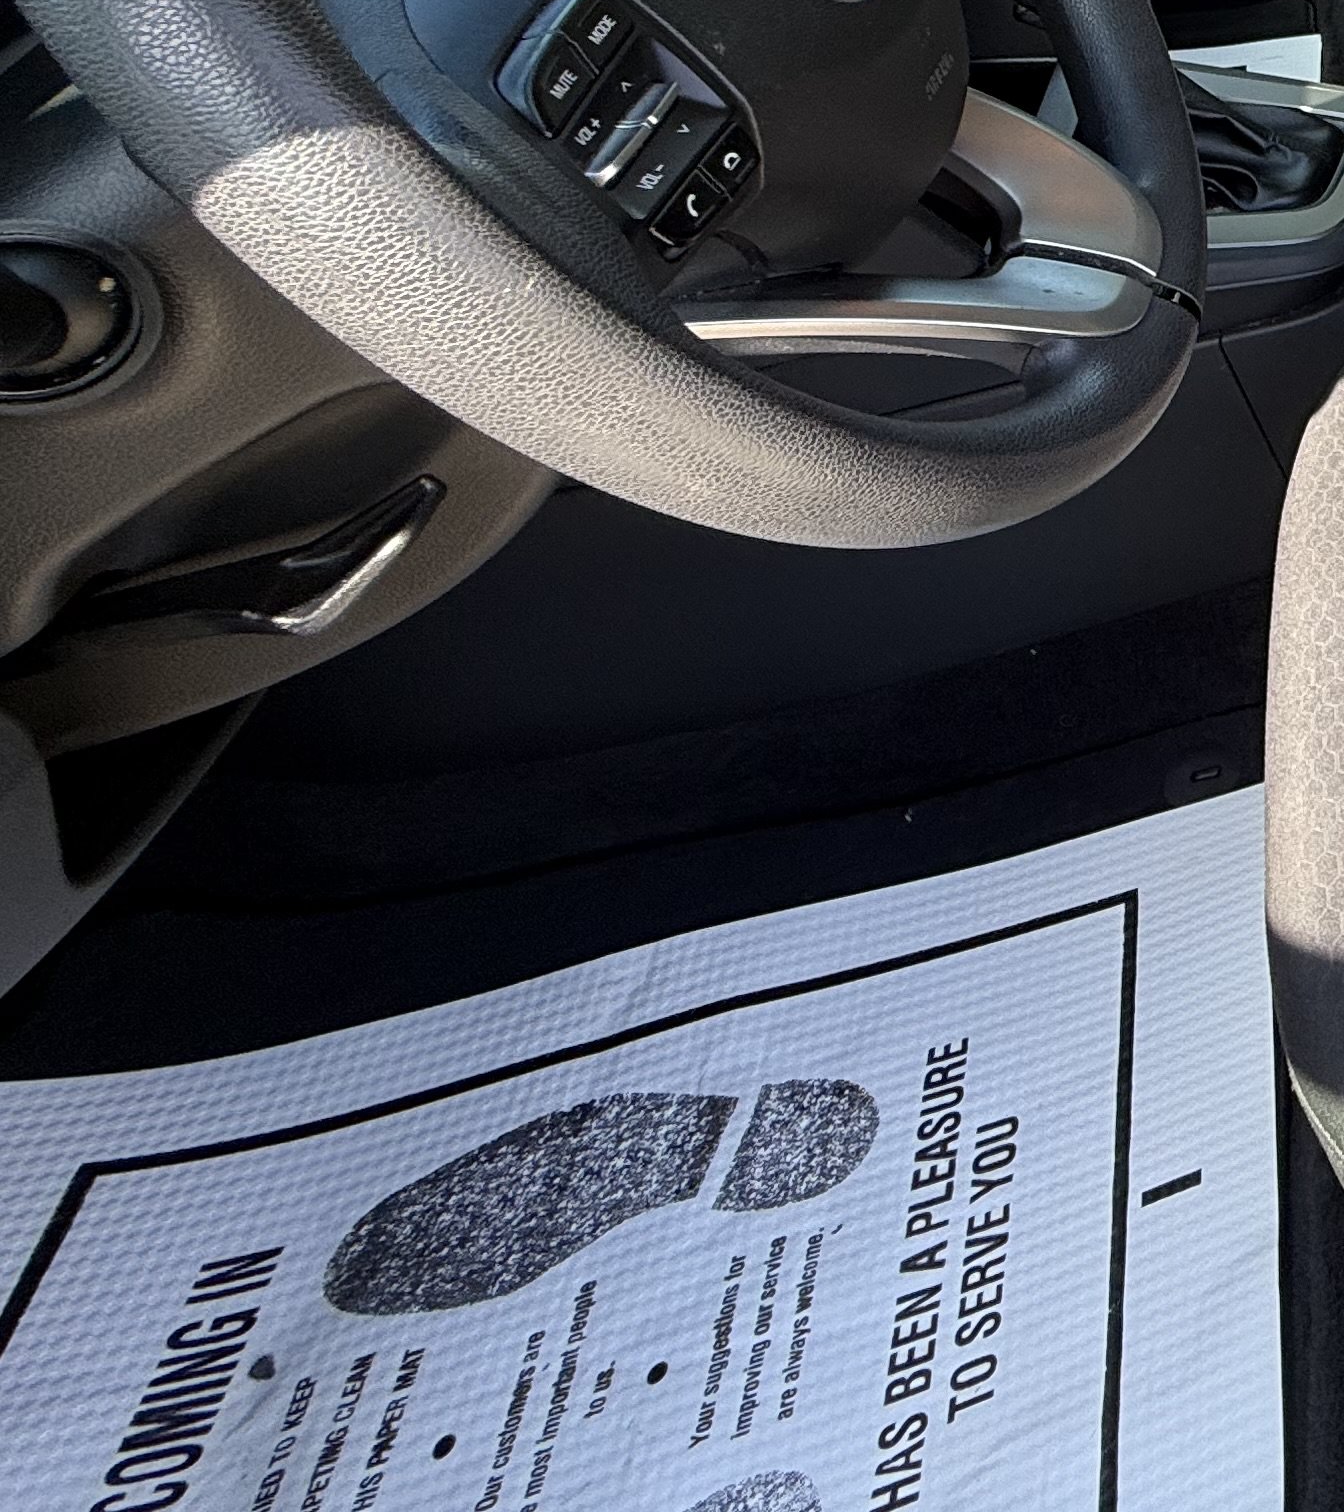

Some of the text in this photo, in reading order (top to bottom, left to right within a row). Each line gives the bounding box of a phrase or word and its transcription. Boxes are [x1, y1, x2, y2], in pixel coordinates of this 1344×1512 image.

[587, 14, 617, 46] MODE
[550, 69, 579, 100] MUTE
[761, 1235, 787, 1300] service
[868, 1037, 969, 1512] HAS BEEN A PLEASURE
[947, 1115, 1019, 1424] TO SERVE YOU
[688, 1255, 747, 1449] Your suggestions for
[754, 1303, 773, 1338] our
[778, 1227, 825, 1421] are always welcome.
[89, 1246, 286, 1512] COMING IN
[281, 1376, 318, 1432] KEEP
[333, 1351, 377, 1422] CLEAN
[366, 1395, 409, 1470] PAPER
[393, 1347, 426, 1392] MAT
[474, 1473, 504, 1512] Our
[492, 1365, 537, 1470] customers
[523, 1330, 546, 1363] are
[523, 1445, 554, 1500] most
[567, 1280, 597, 1346] people
[583, 1360, 616, 1419] to us.
[267, 1436, 297, 1469] TO
